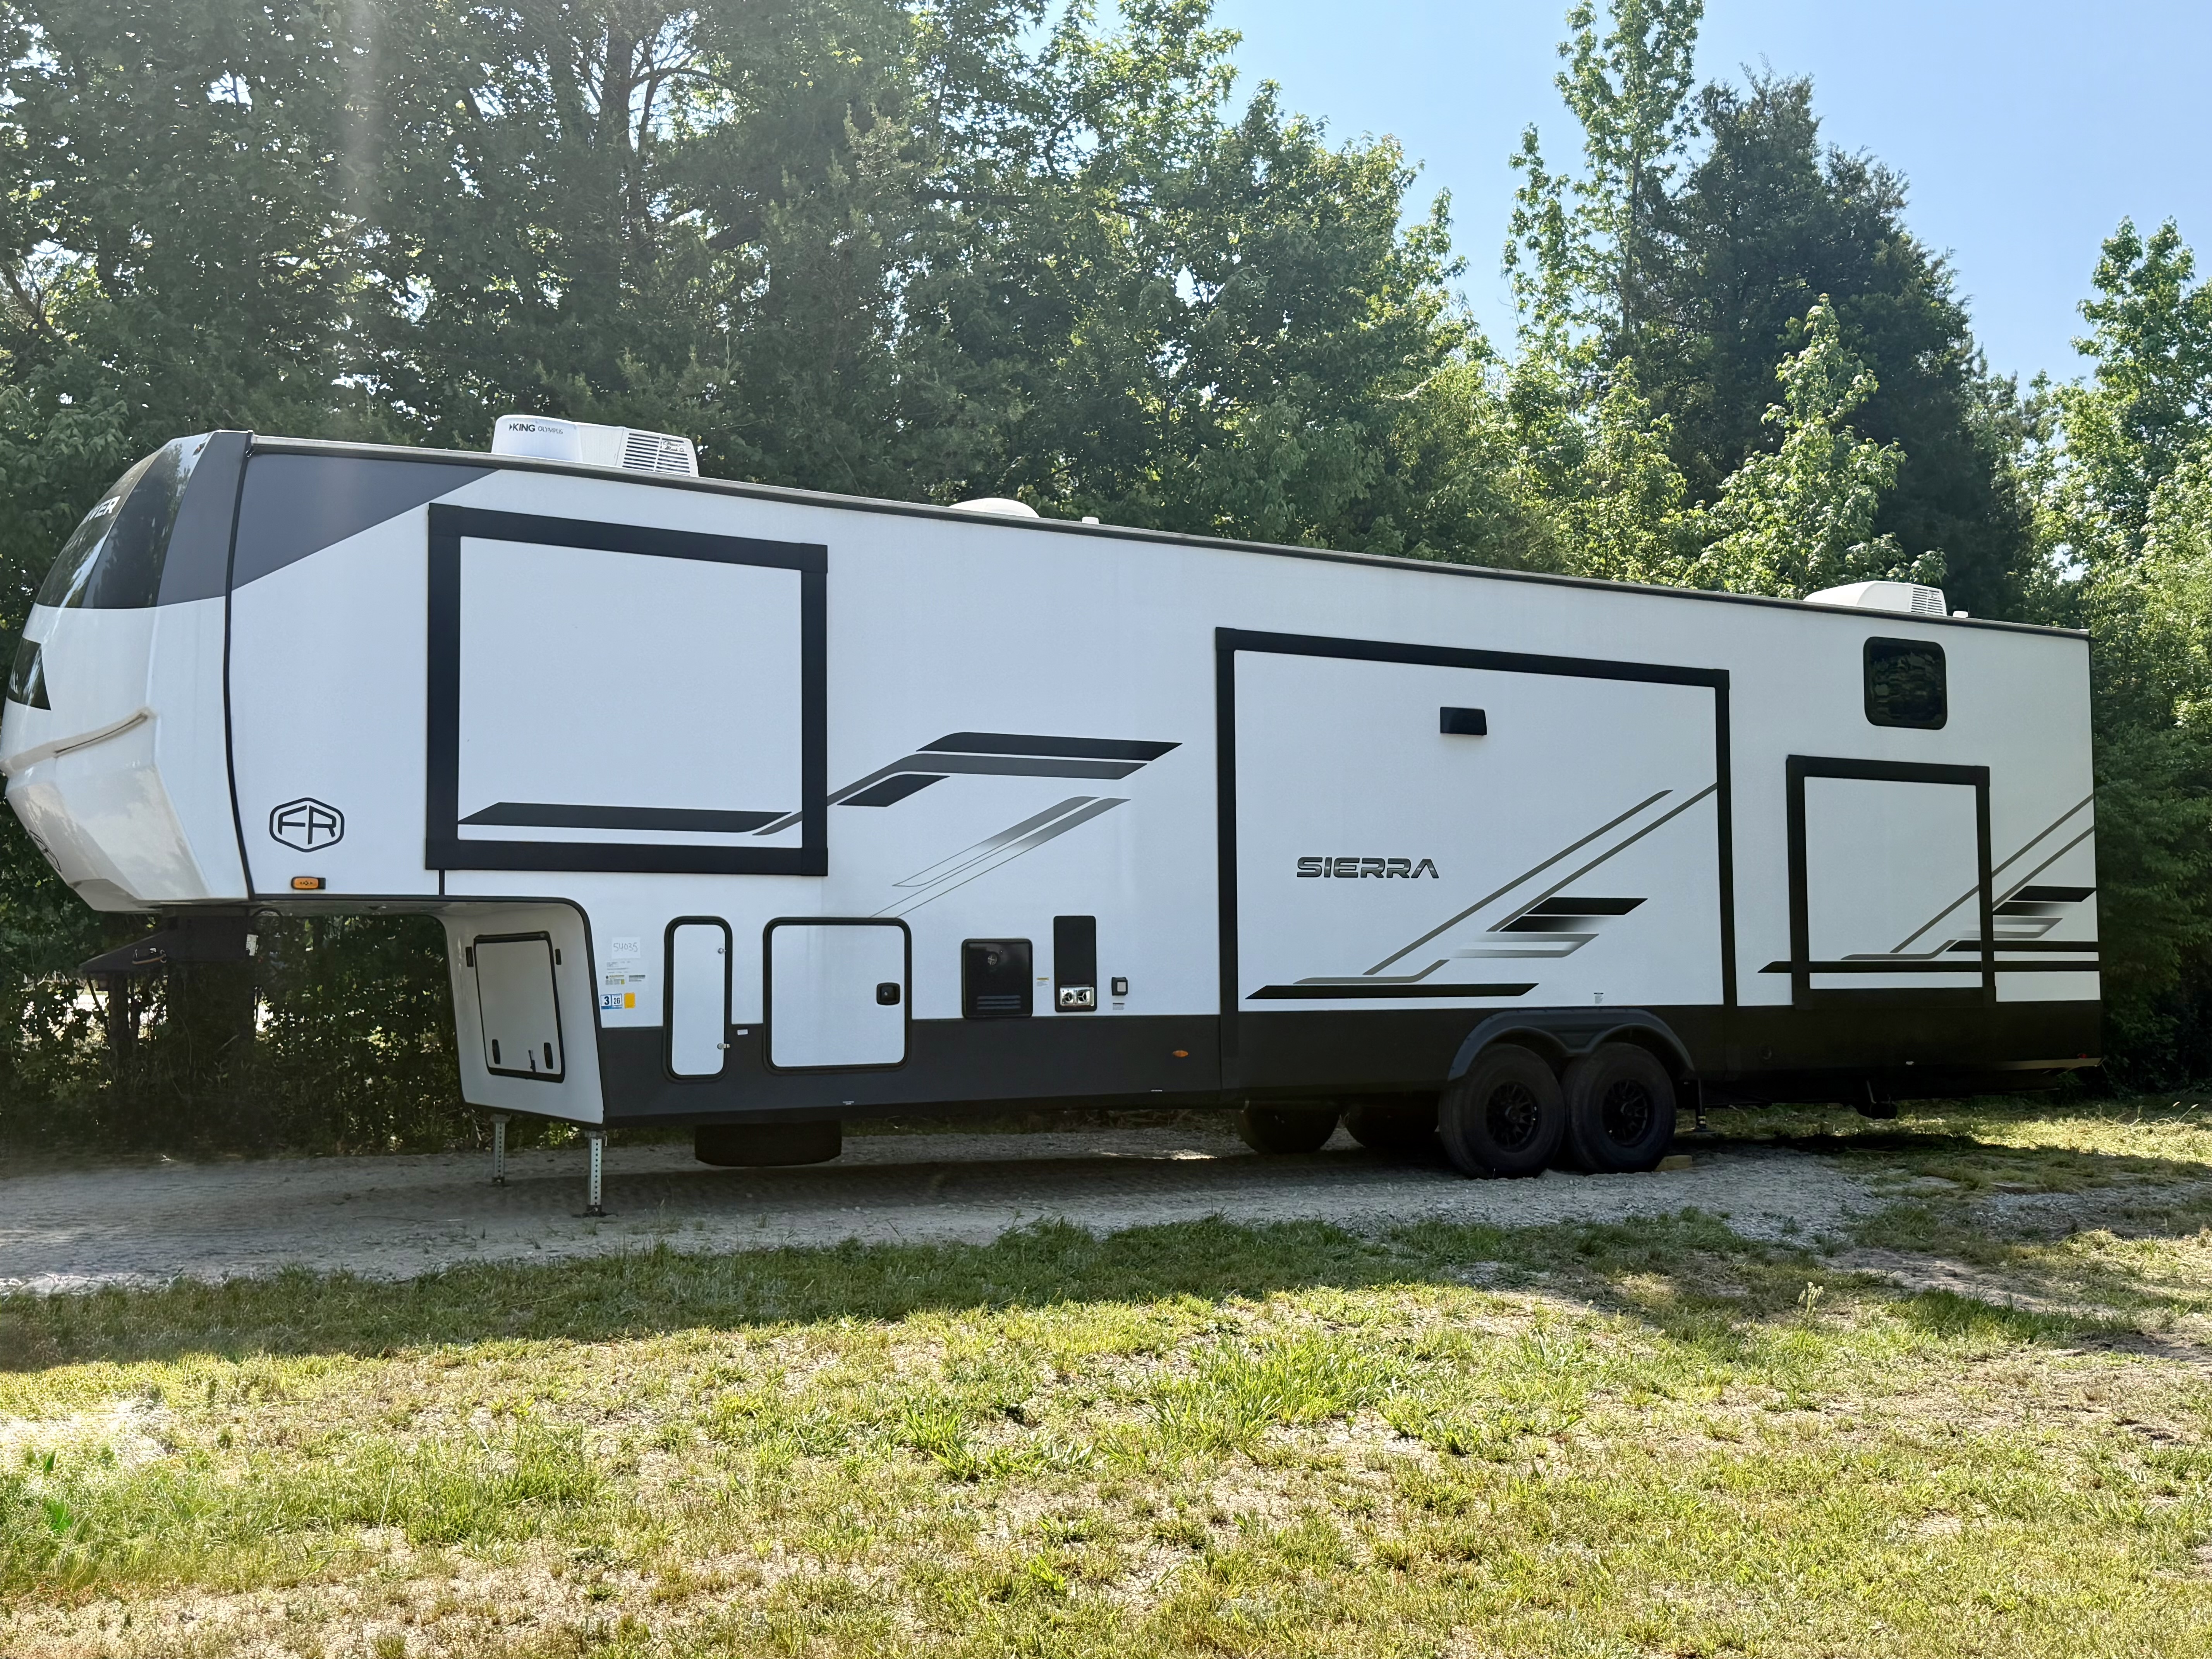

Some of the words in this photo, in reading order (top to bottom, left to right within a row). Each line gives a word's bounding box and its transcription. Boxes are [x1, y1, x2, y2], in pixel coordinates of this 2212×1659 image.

[513, 423, 535, 432] KING
[1297, 857, 1439, 879] SIERRA
[613, 942, 638, 953] 54035
[604, 996, 610, 1005] 3
